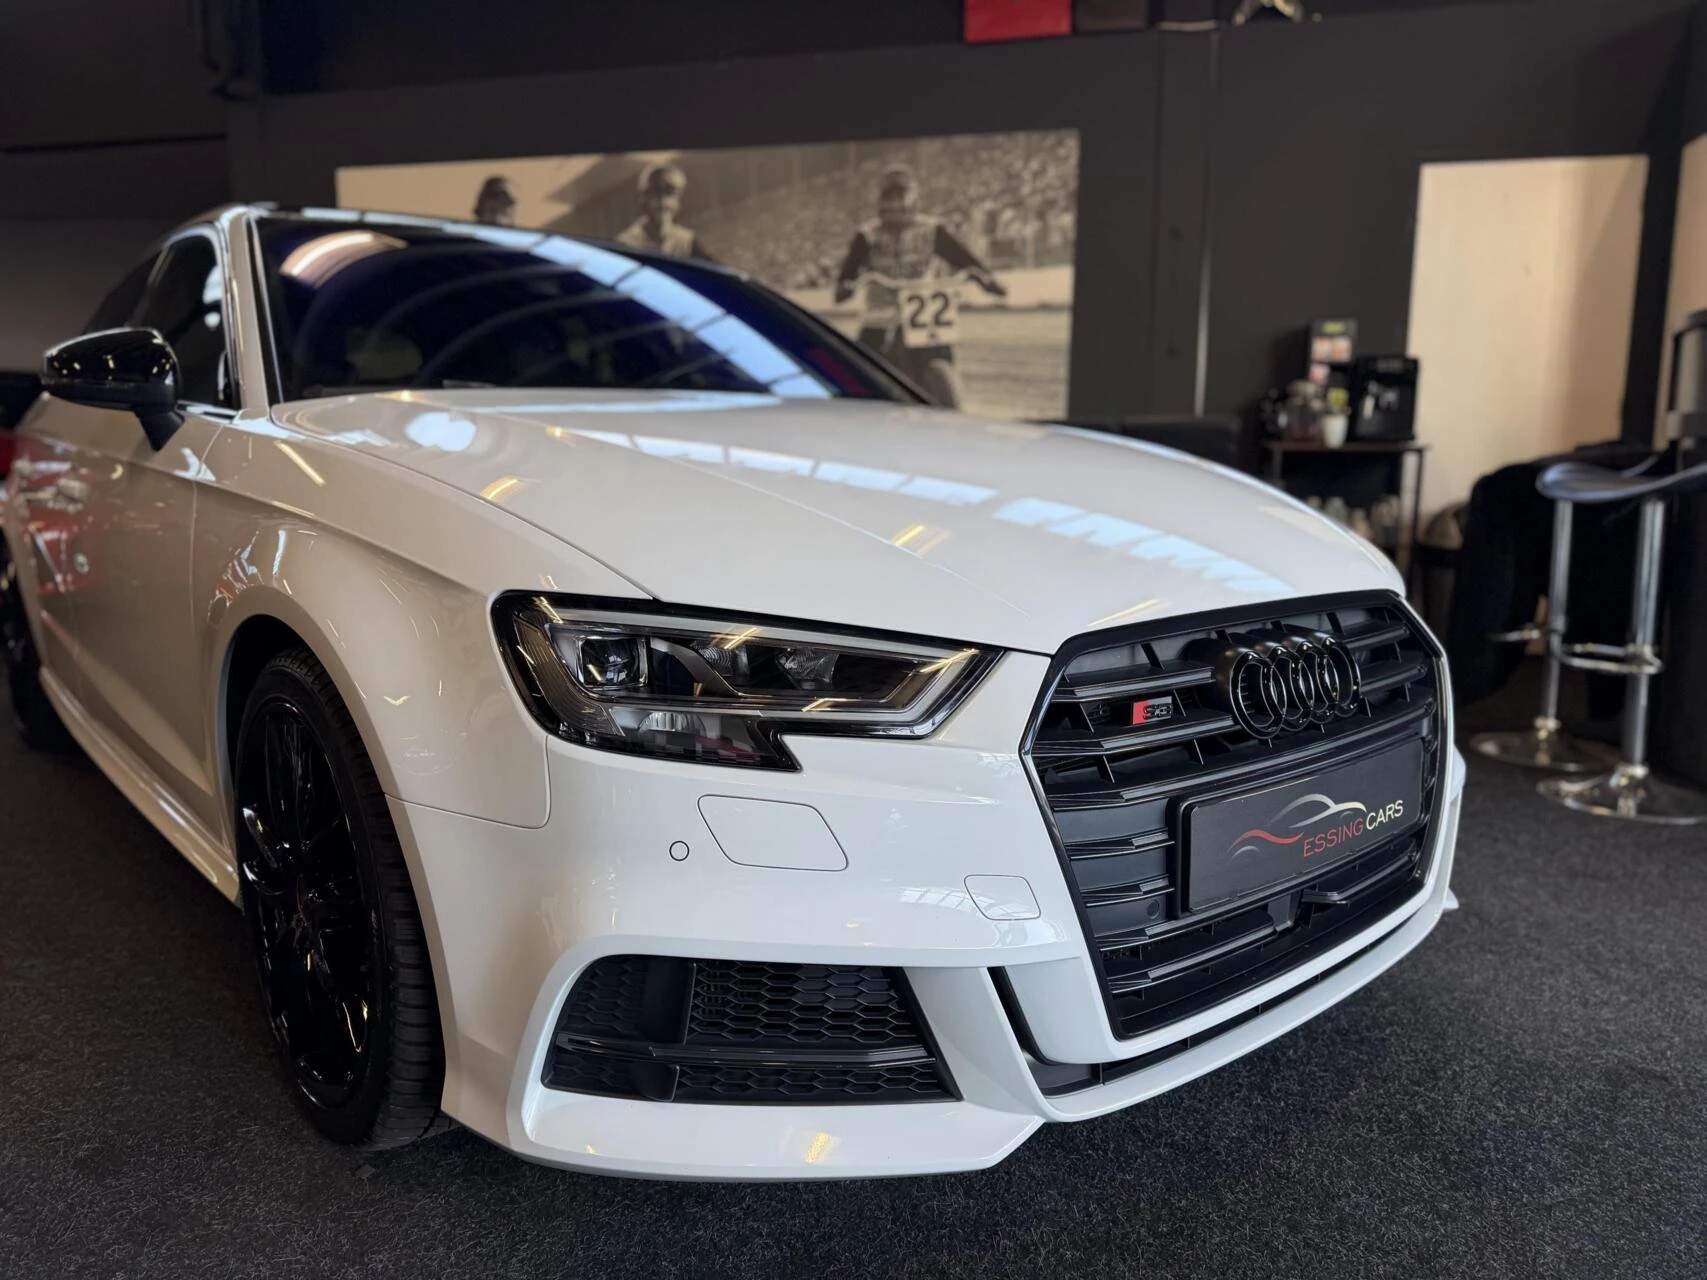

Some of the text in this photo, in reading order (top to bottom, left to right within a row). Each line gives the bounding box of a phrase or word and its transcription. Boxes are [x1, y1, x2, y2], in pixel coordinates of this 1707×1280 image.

[907, 291, 953, 328] 22
[1303, 799, 1404, 857] ESSING CARS
